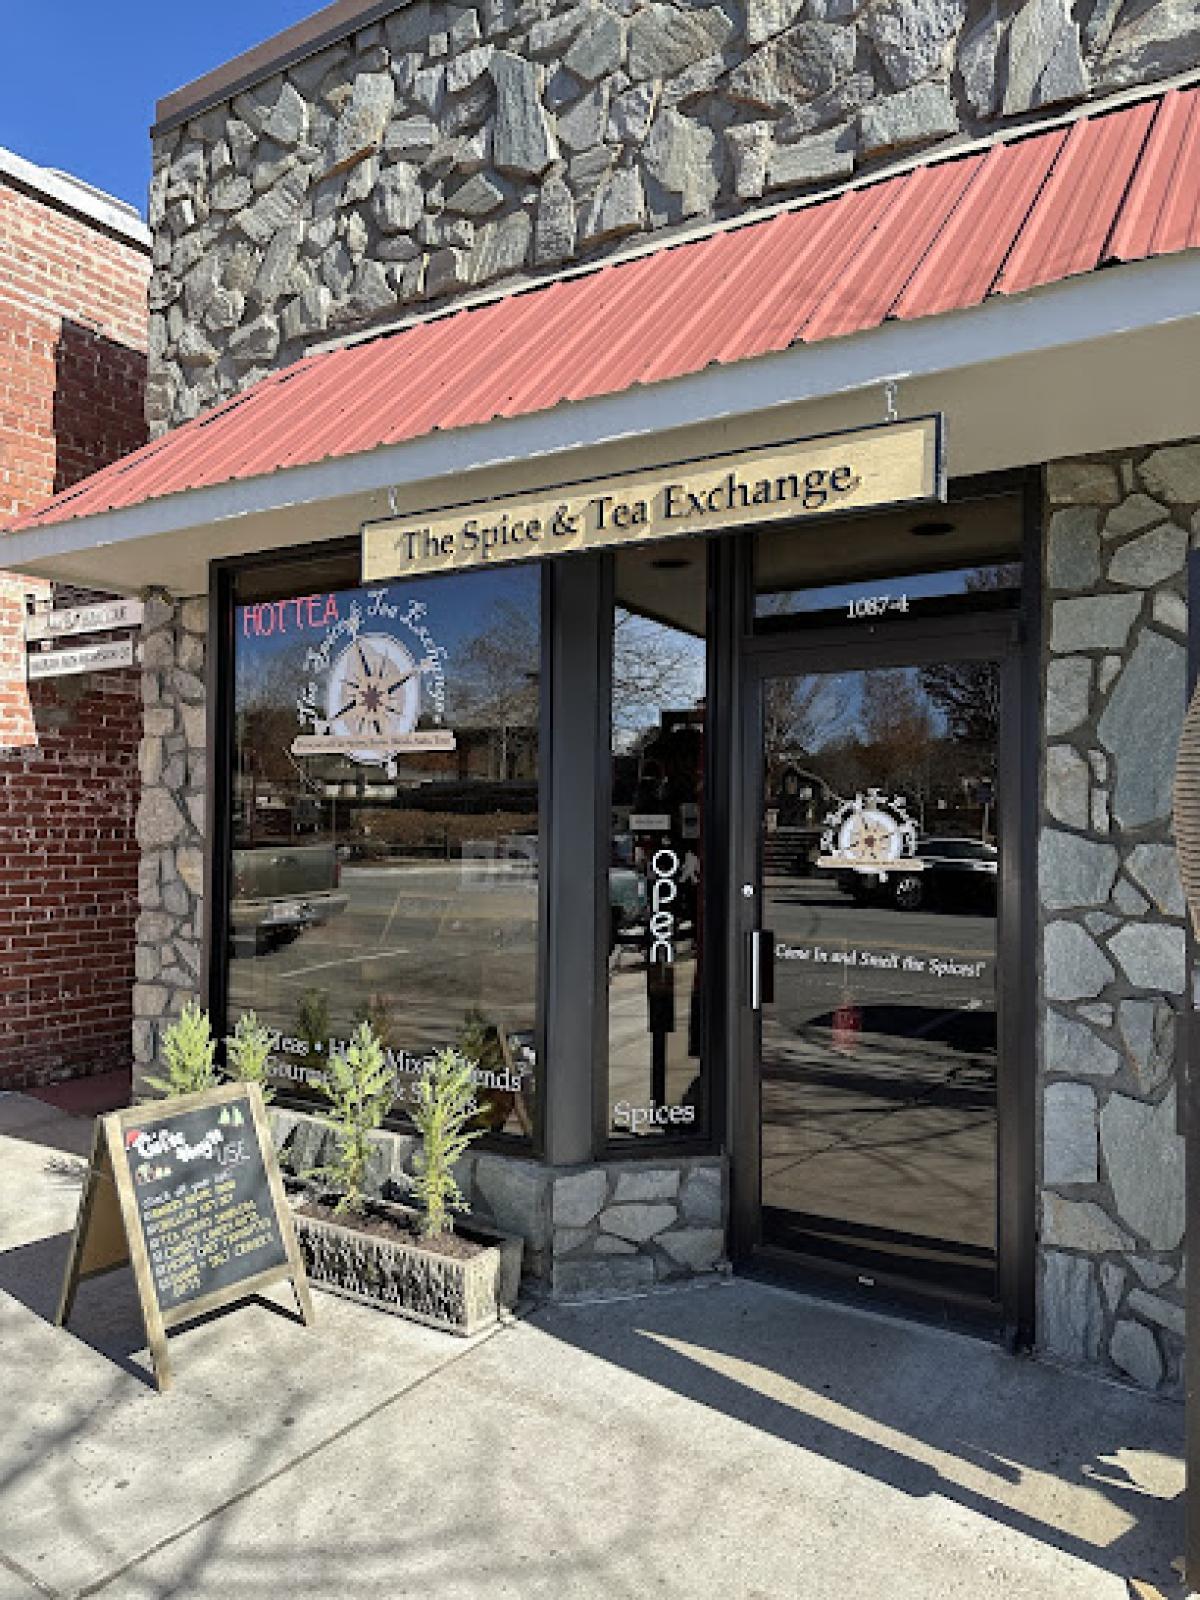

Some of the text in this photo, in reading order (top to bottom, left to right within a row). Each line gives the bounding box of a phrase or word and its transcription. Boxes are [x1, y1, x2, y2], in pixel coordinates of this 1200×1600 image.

[401, 463, 855, 562] The Spice & Tea Exchange
[614, 1100, 695, 1133] Spices
